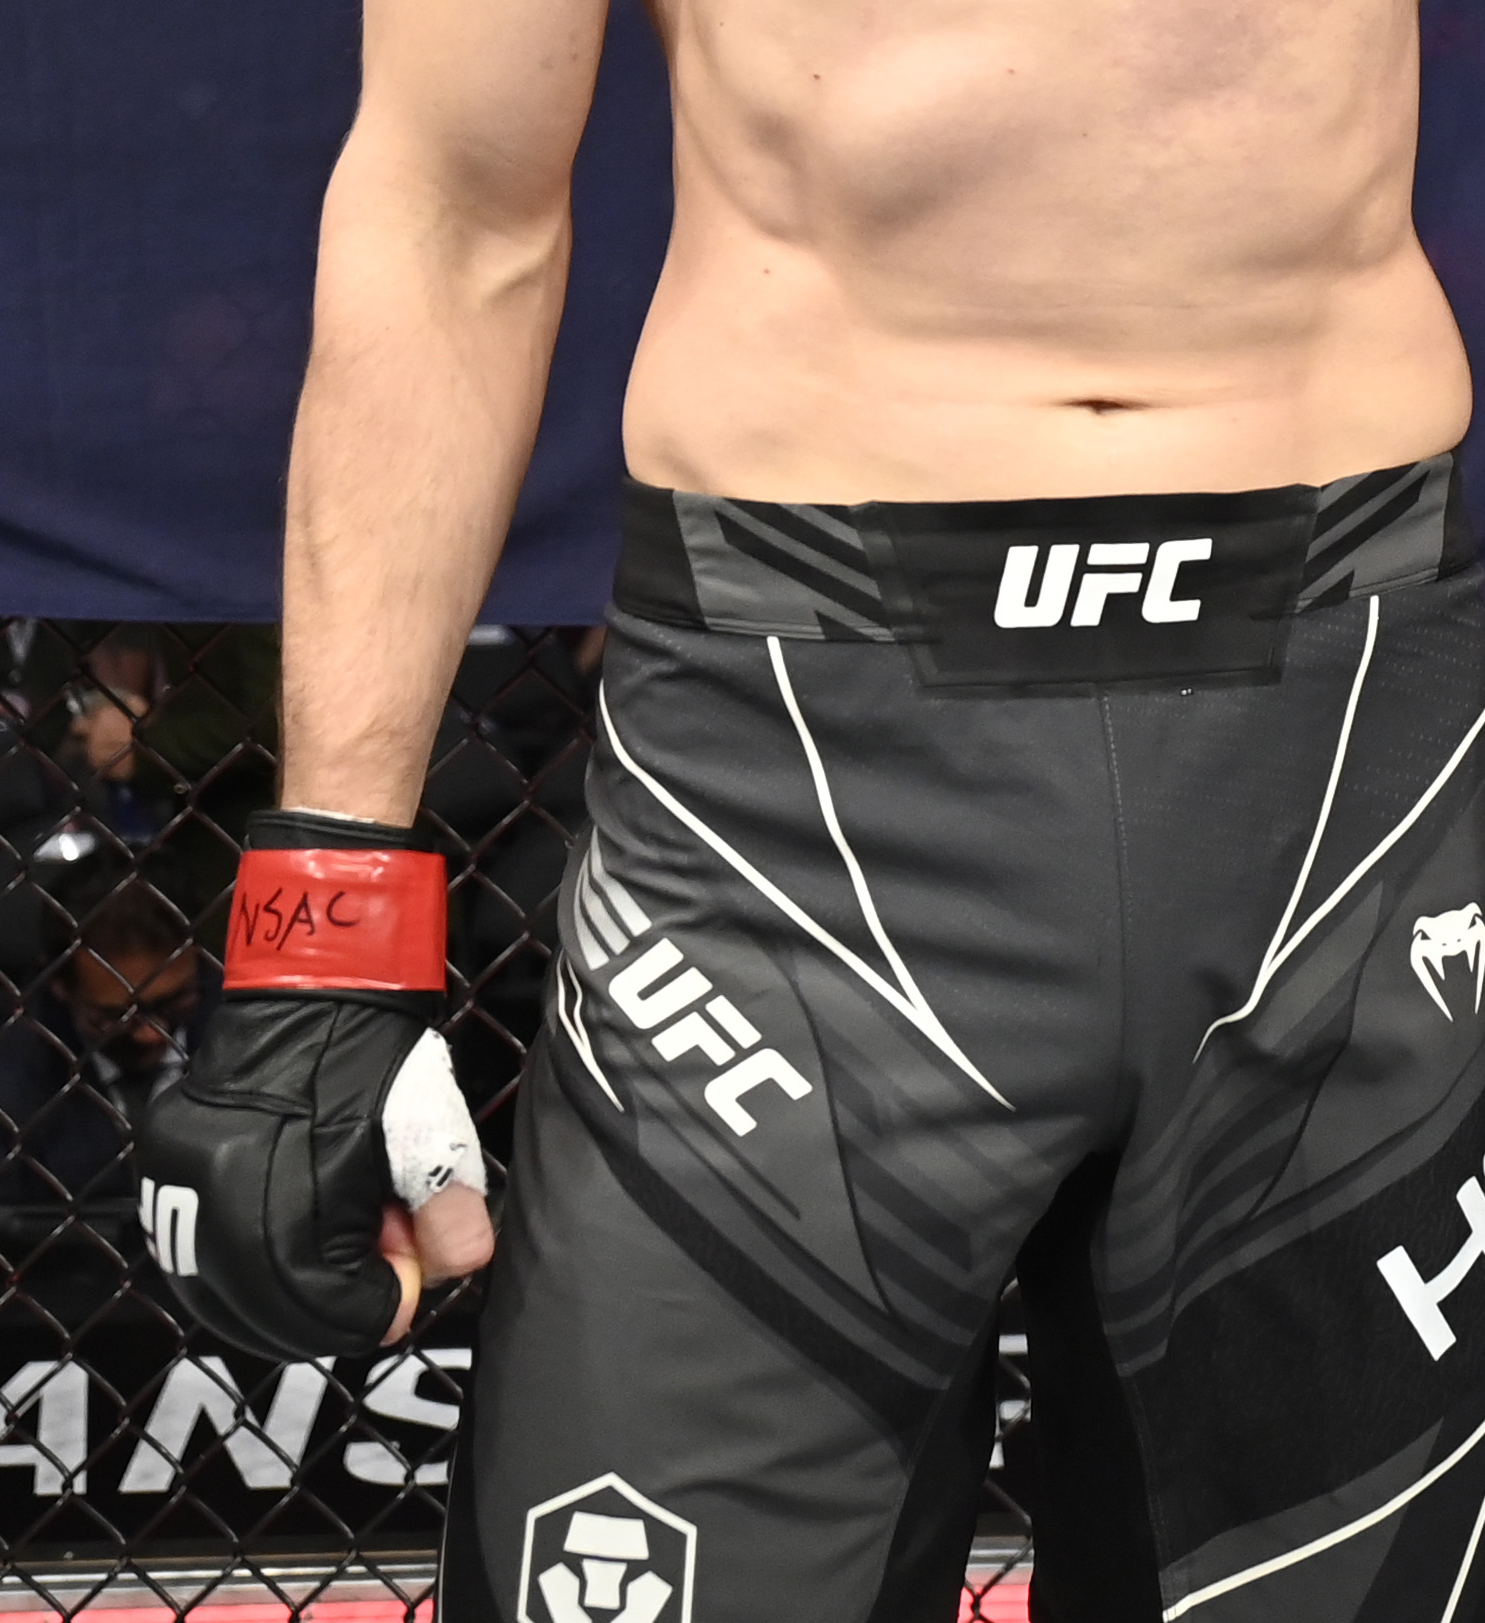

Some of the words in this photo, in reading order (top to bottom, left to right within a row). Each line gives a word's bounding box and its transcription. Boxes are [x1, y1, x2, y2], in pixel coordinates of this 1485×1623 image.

[993, 537, 1213, 629] UFC
[229, 887, 361, 952] NSAC
[608, 937, 813, 1137] UFC
